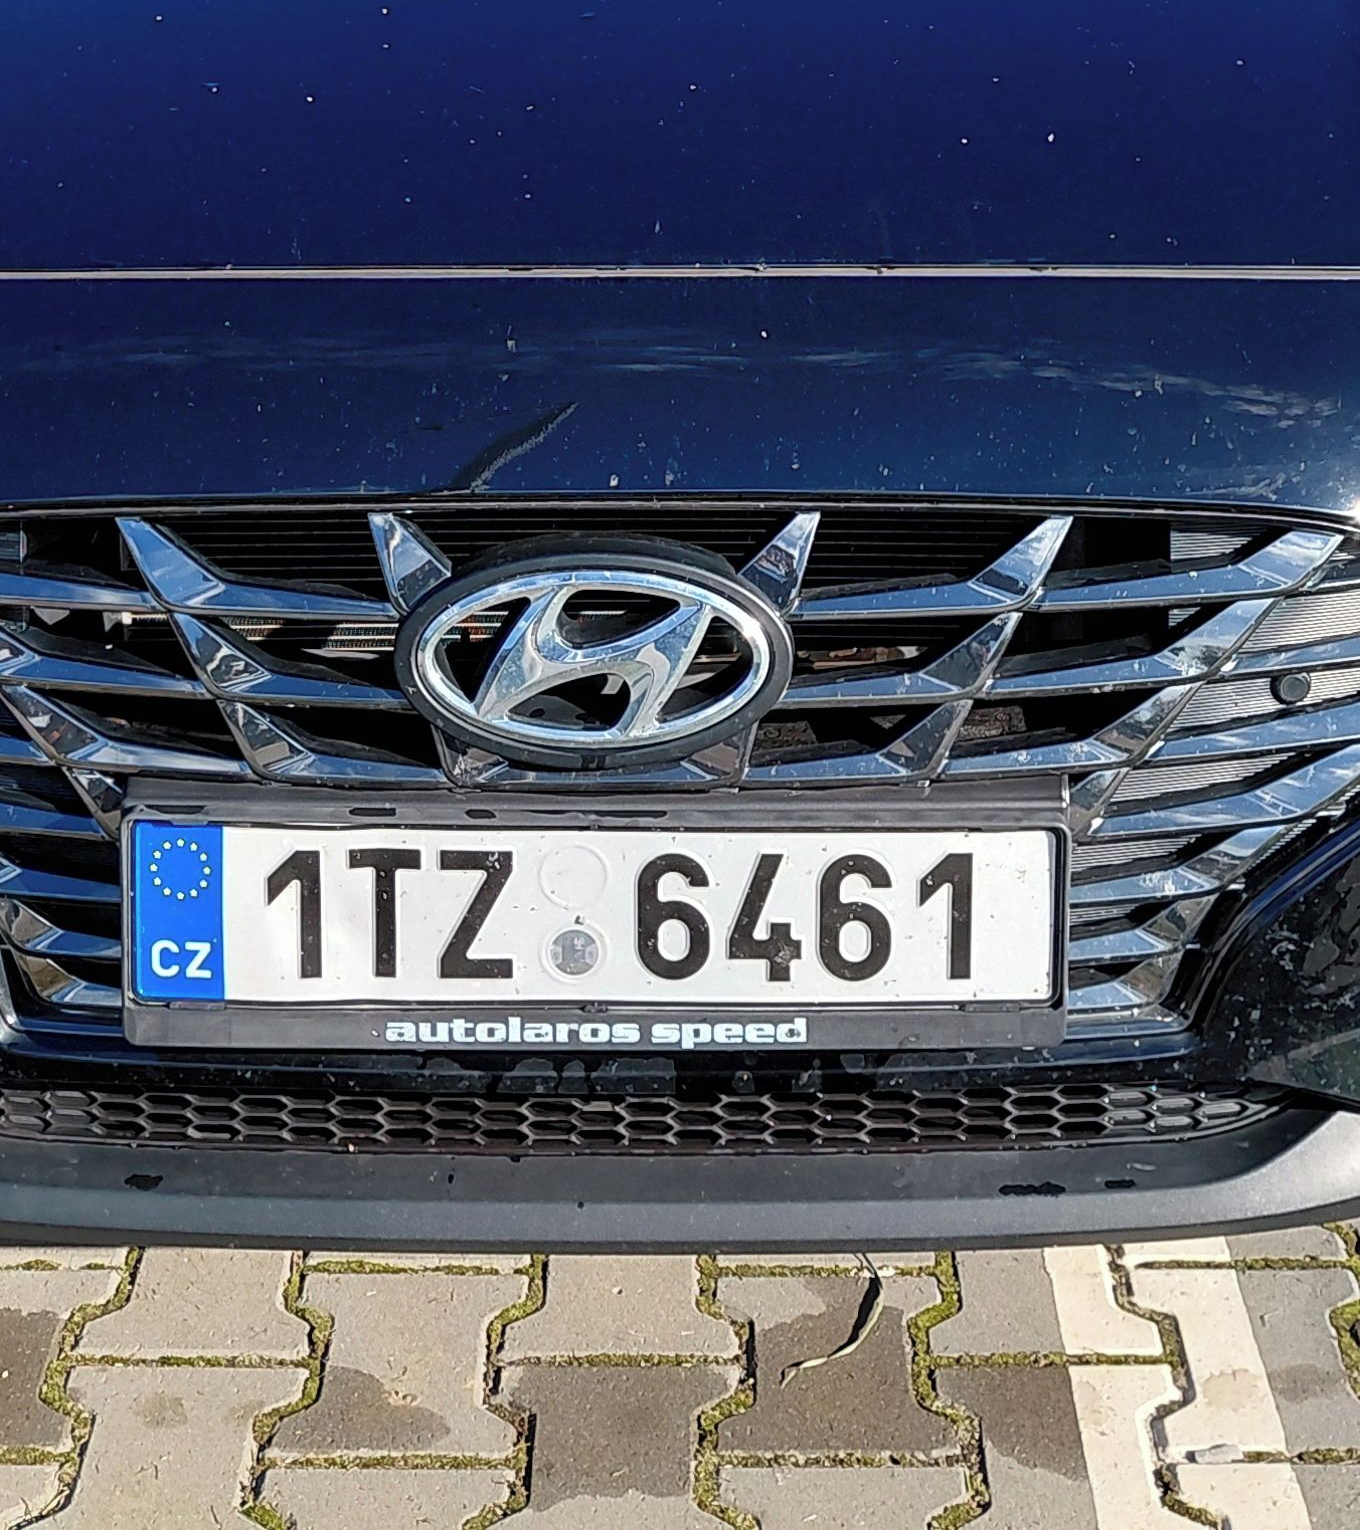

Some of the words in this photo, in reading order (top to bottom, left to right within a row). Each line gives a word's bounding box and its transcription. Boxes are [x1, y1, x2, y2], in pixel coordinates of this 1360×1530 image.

[265, 848, 514, 980] 1TZ
[637, 851, 974, 983] 6461
[150, 939, 214, 980] CZ
[384, 1016, 641, 1045] autolaros
[650, 1017, 808, 1050] speed
